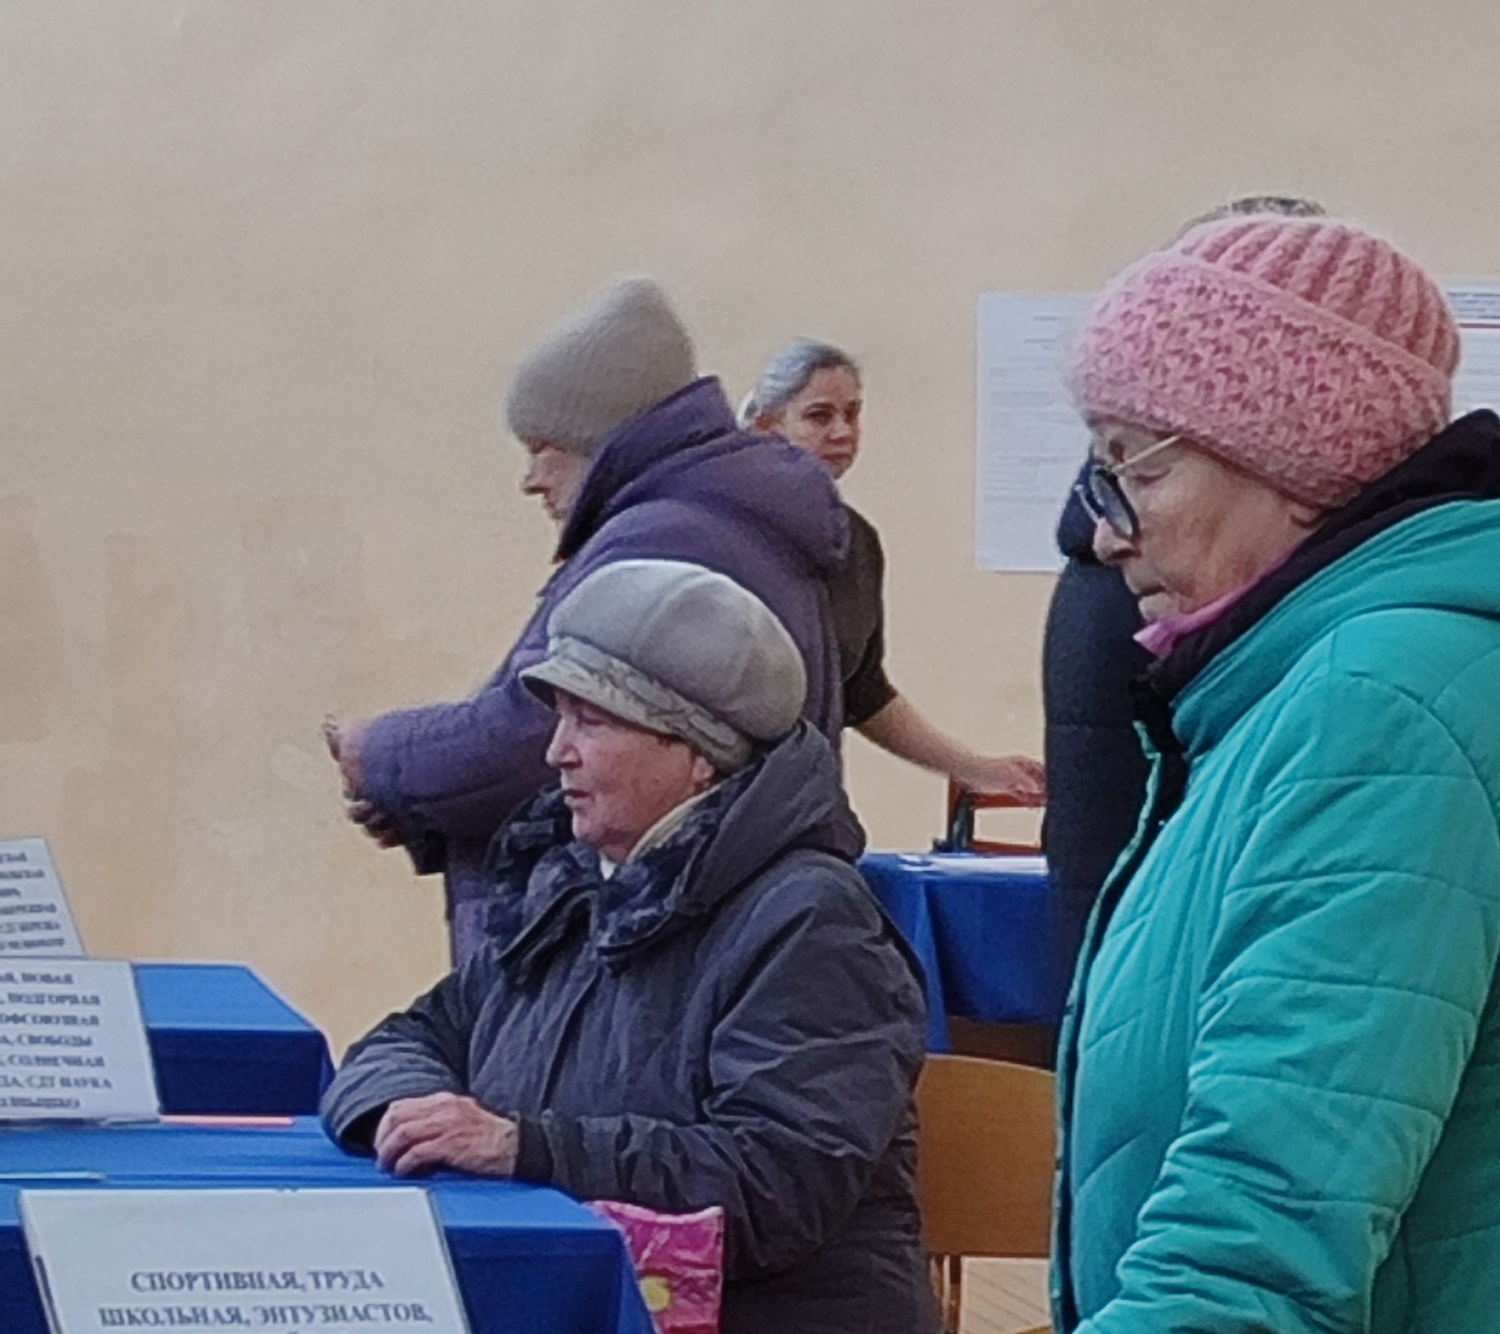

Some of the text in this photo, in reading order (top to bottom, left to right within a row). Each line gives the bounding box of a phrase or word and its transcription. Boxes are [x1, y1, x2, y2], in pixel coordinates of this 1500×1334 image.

[130, 1269, 385, 1293] СПОРТИВНАЯ, ТРУДА
[97, 1302, 434, 1328] ШКОЛЬНАЯ, ЭНТУЗИАСТОВ,
